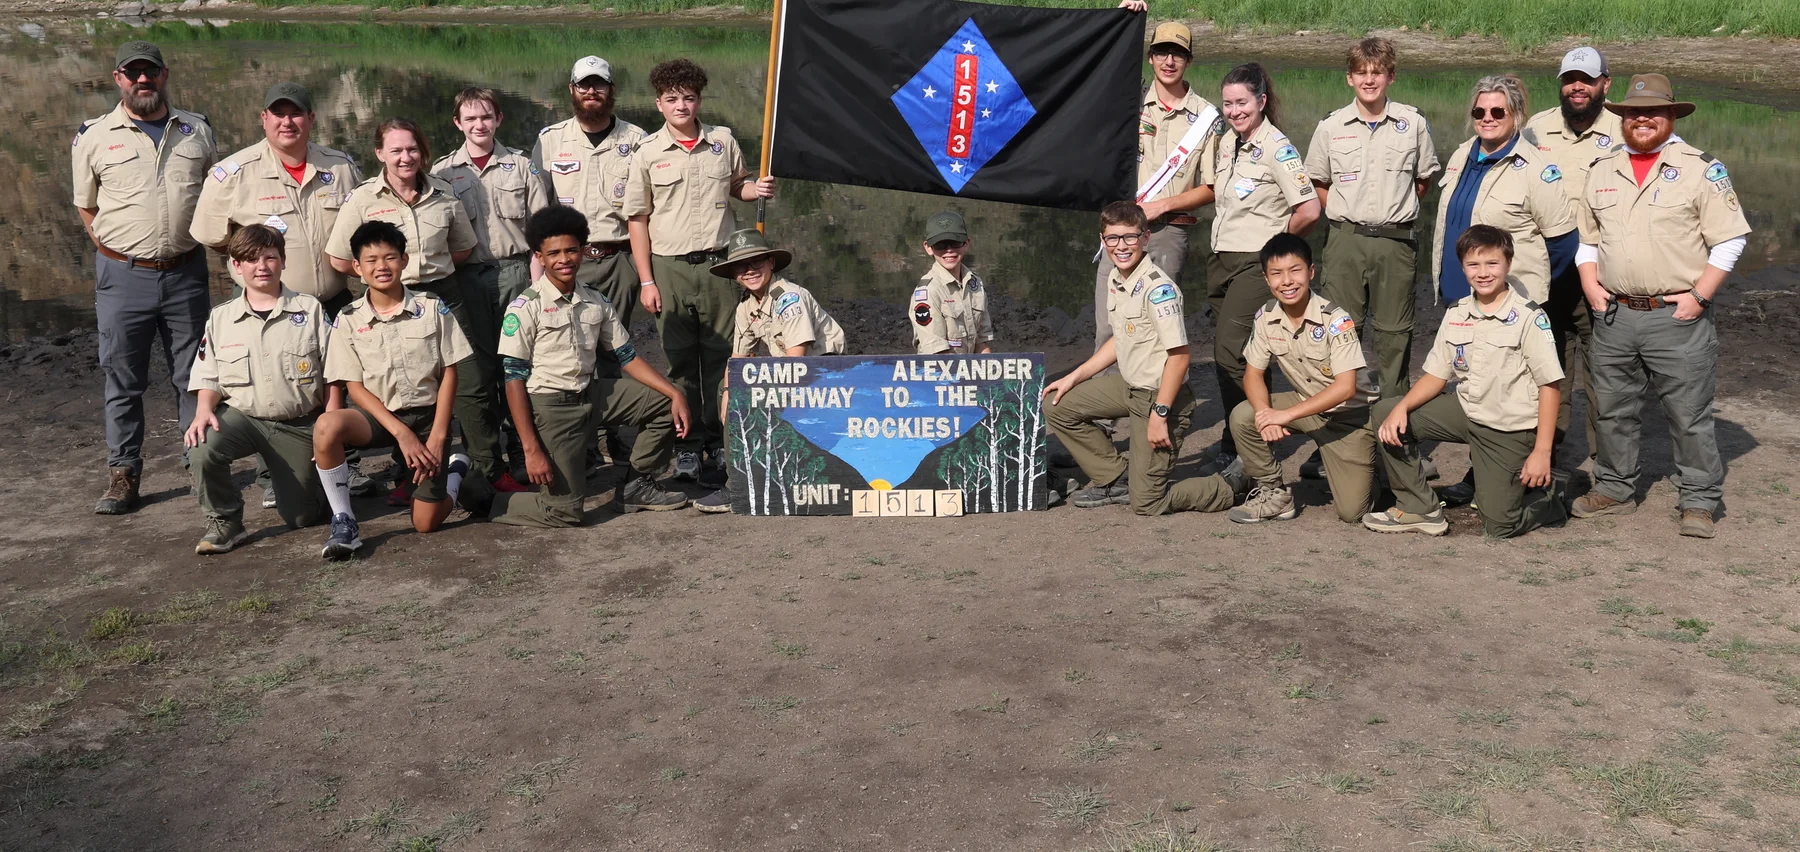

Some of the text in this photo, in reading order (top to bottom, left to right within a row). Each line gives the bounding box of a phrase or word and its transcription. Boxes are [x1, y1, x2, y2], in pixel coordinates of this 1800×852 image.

[951, 60, 972, 153] 1513
[742, 358, 1032, 384] CAMP ALEXANDER
[751, 385, 978, 409] PATHWAY TO THE
[847, 416, 960, 439] ROCKIES!
[792, 484, 850, 505] UNIT:
